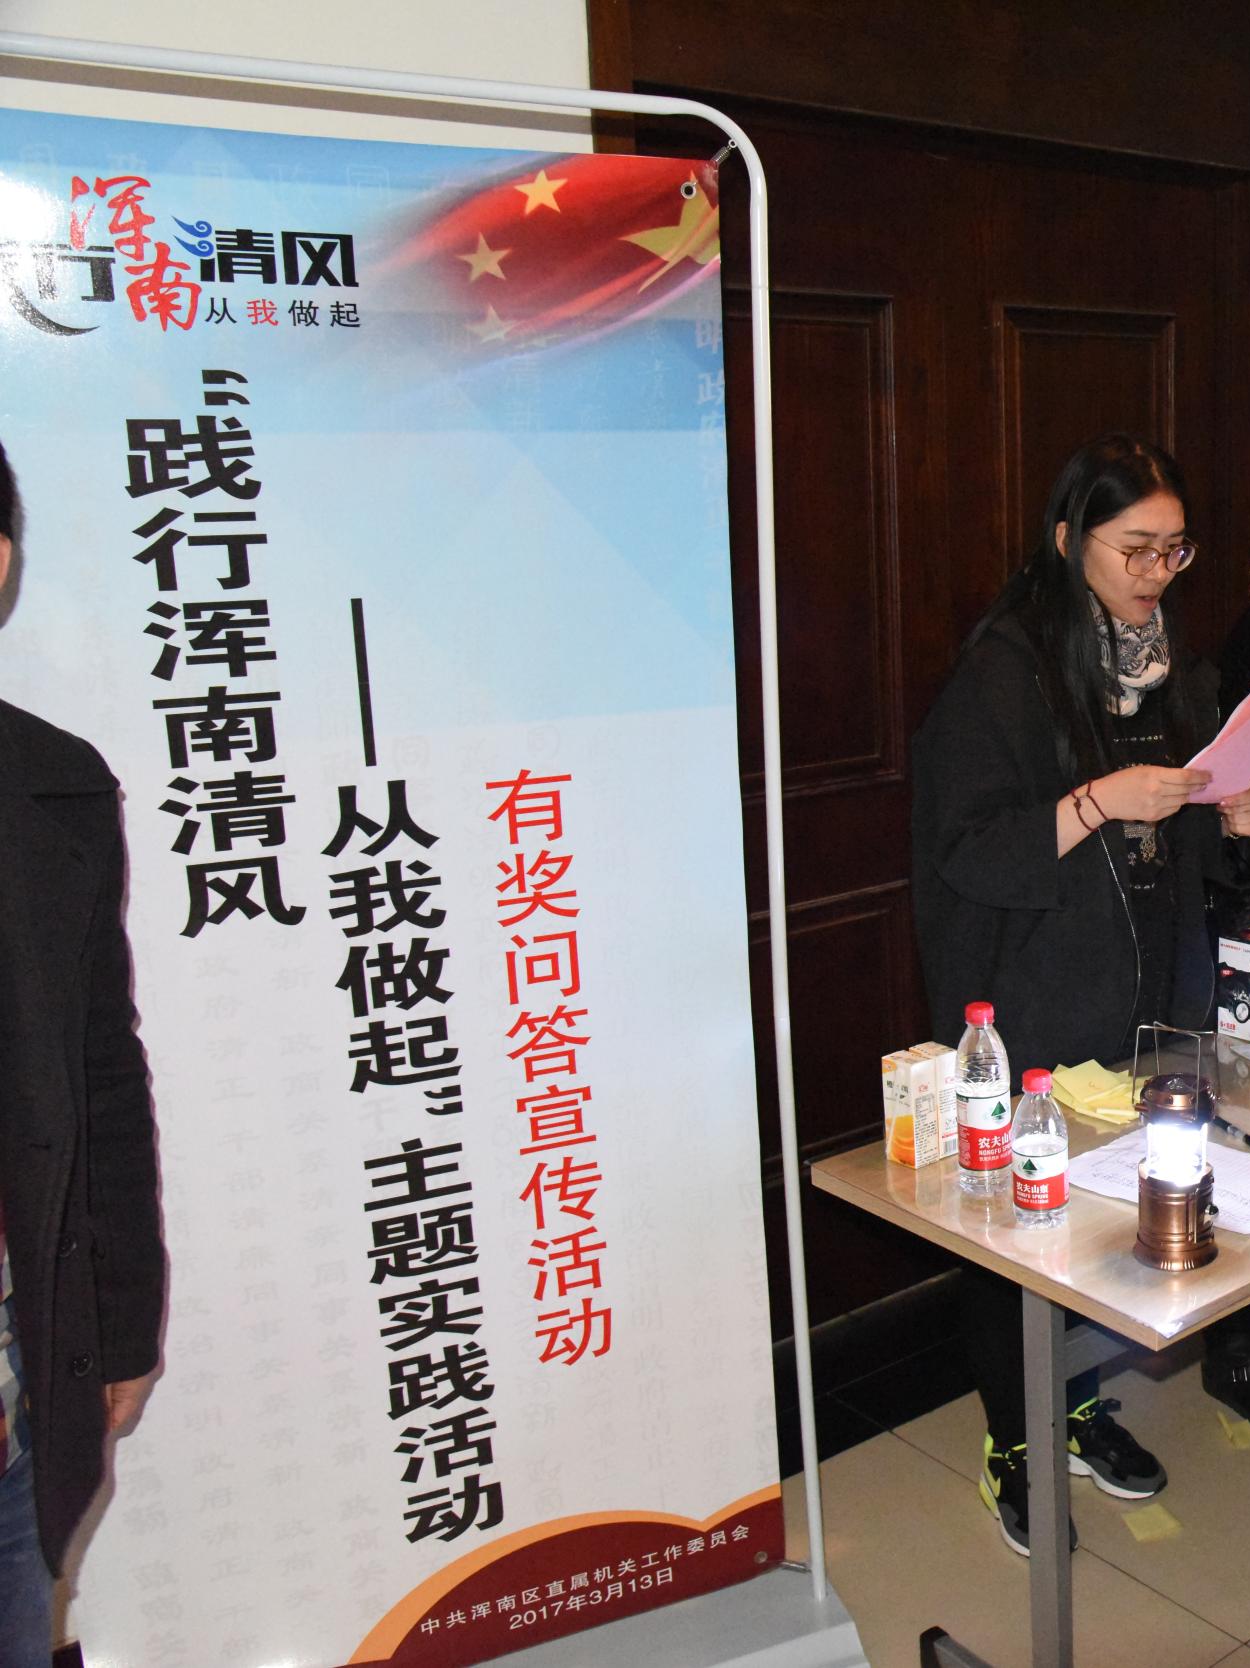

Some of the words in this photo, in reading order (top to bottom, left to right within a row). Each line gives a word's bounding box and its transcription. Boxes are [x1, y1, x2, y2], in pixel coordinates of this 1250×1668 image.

[204, 297, 361, 329] 从我做起
[486, 768, 612, 1367] 有奖问答宣传活动
[978, 1132, 1012, 1149] 农夫山
[421, 1525, 750, 1635] 中共浑南区直属机关工作委员会
[509, 1567, 674, 1630] 2017年3月13日
